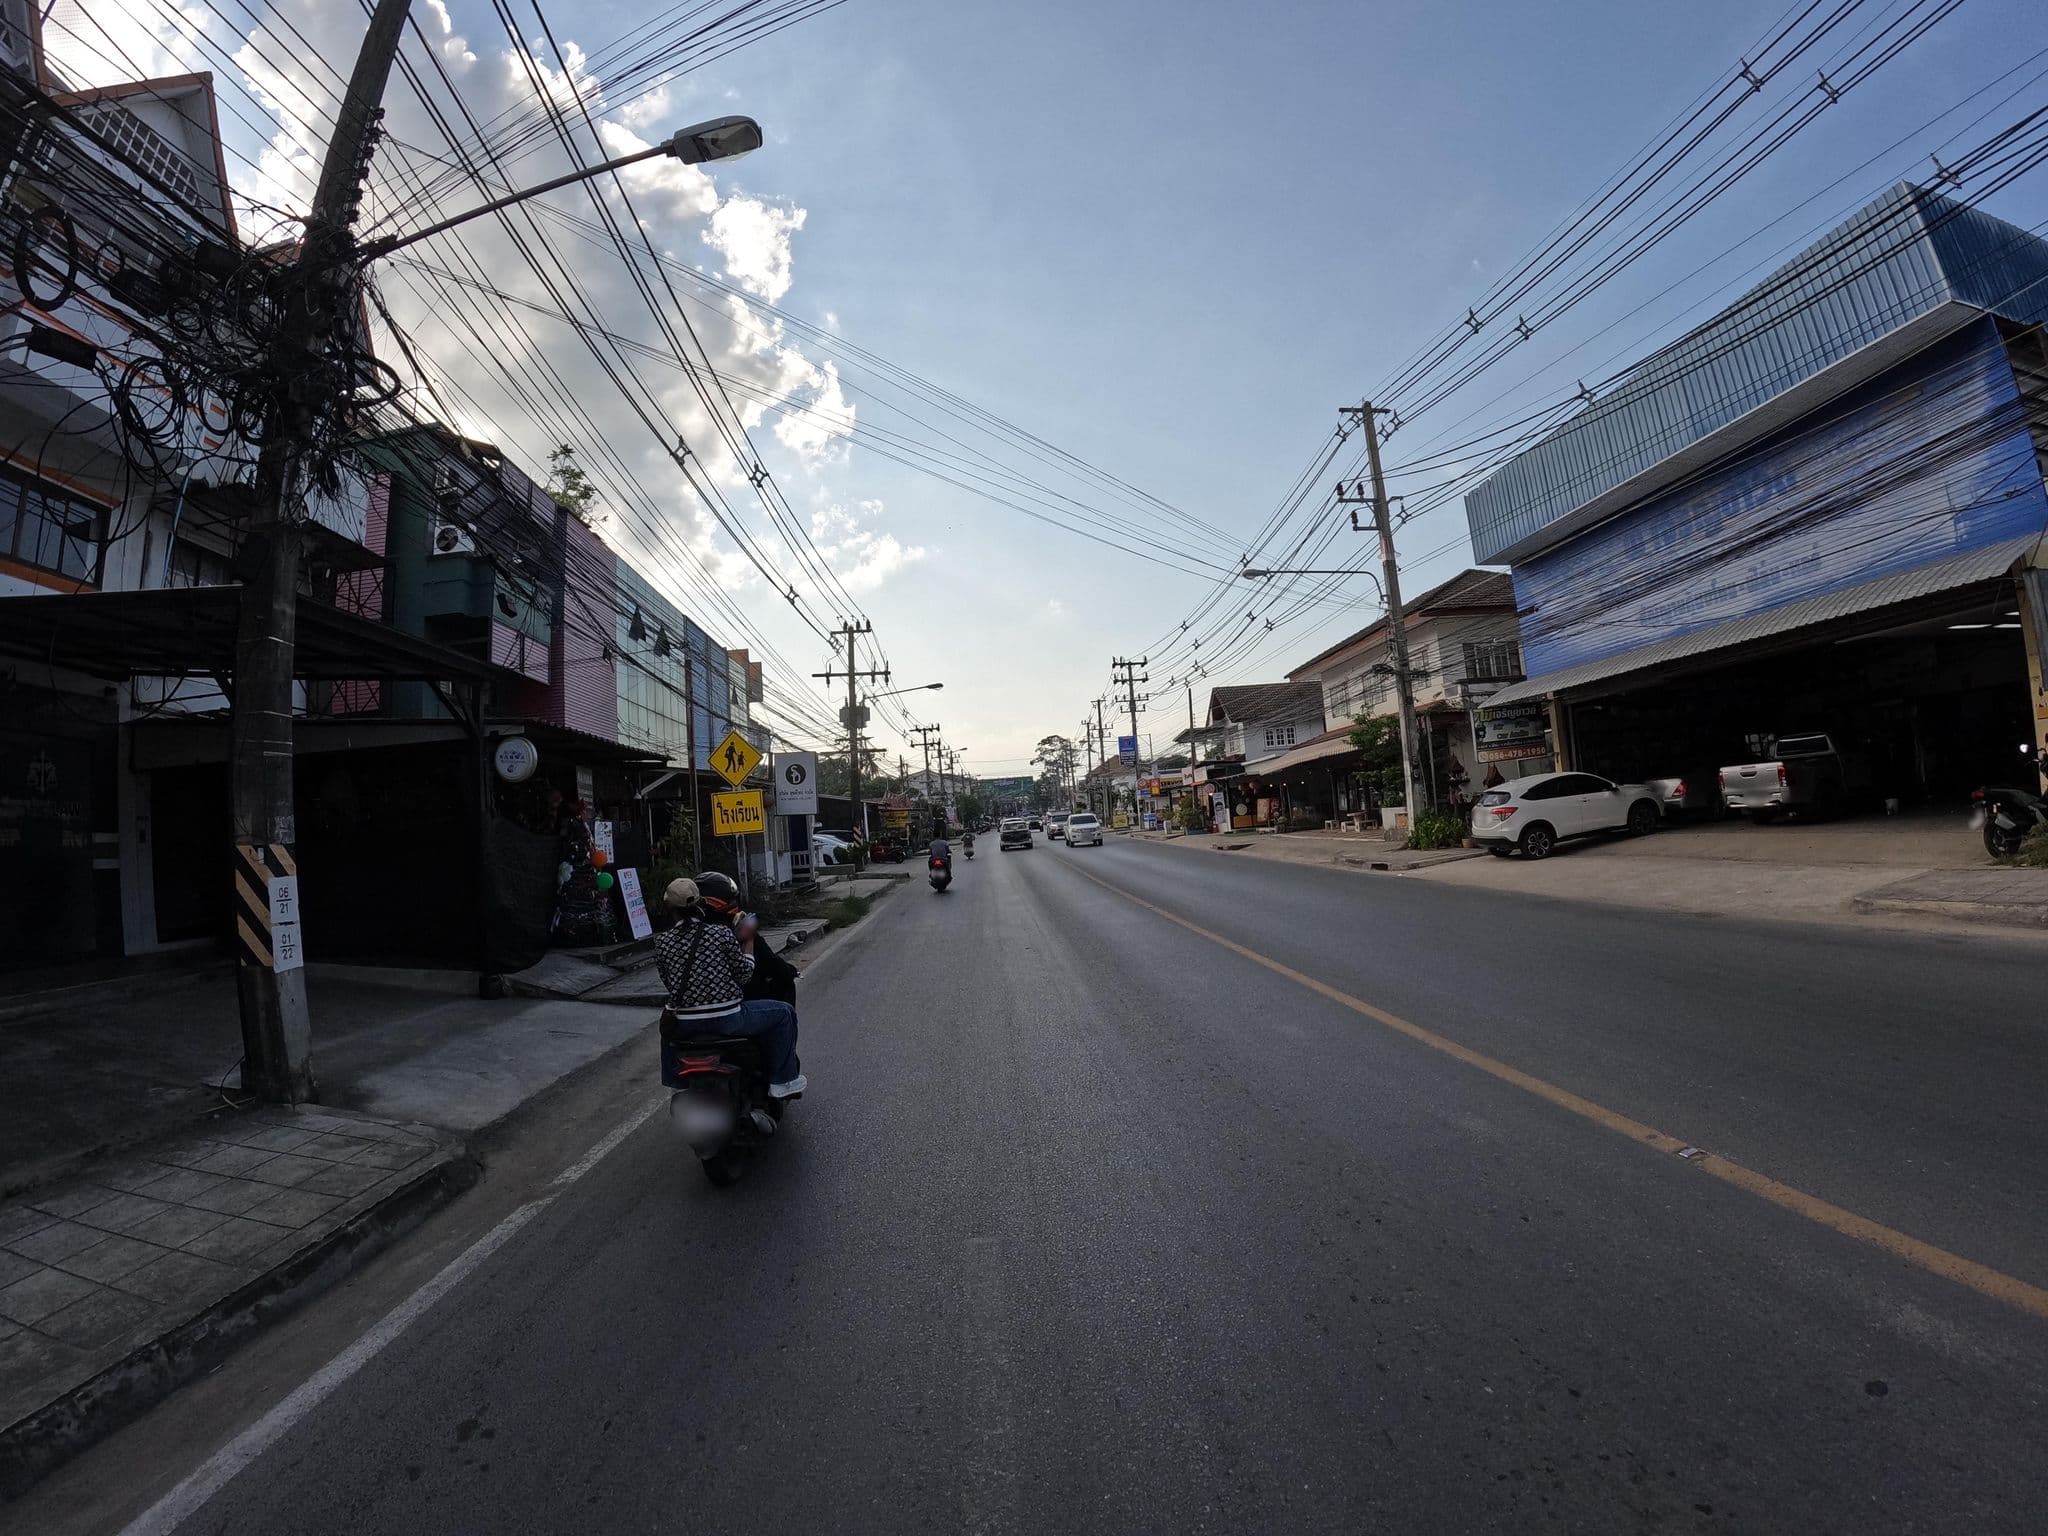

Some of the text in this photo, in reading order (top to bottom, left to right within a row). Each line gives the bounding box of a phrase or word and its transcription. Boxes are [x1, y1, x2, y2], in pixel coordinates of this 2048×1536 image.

[716, 800, 760, 824] โรงเรียน
[278, 886, 289, 898] 06
[279, 902, 289, 914] 21
[281, 933, 291, 945] 01
[282, 947, 293, 960] 22
